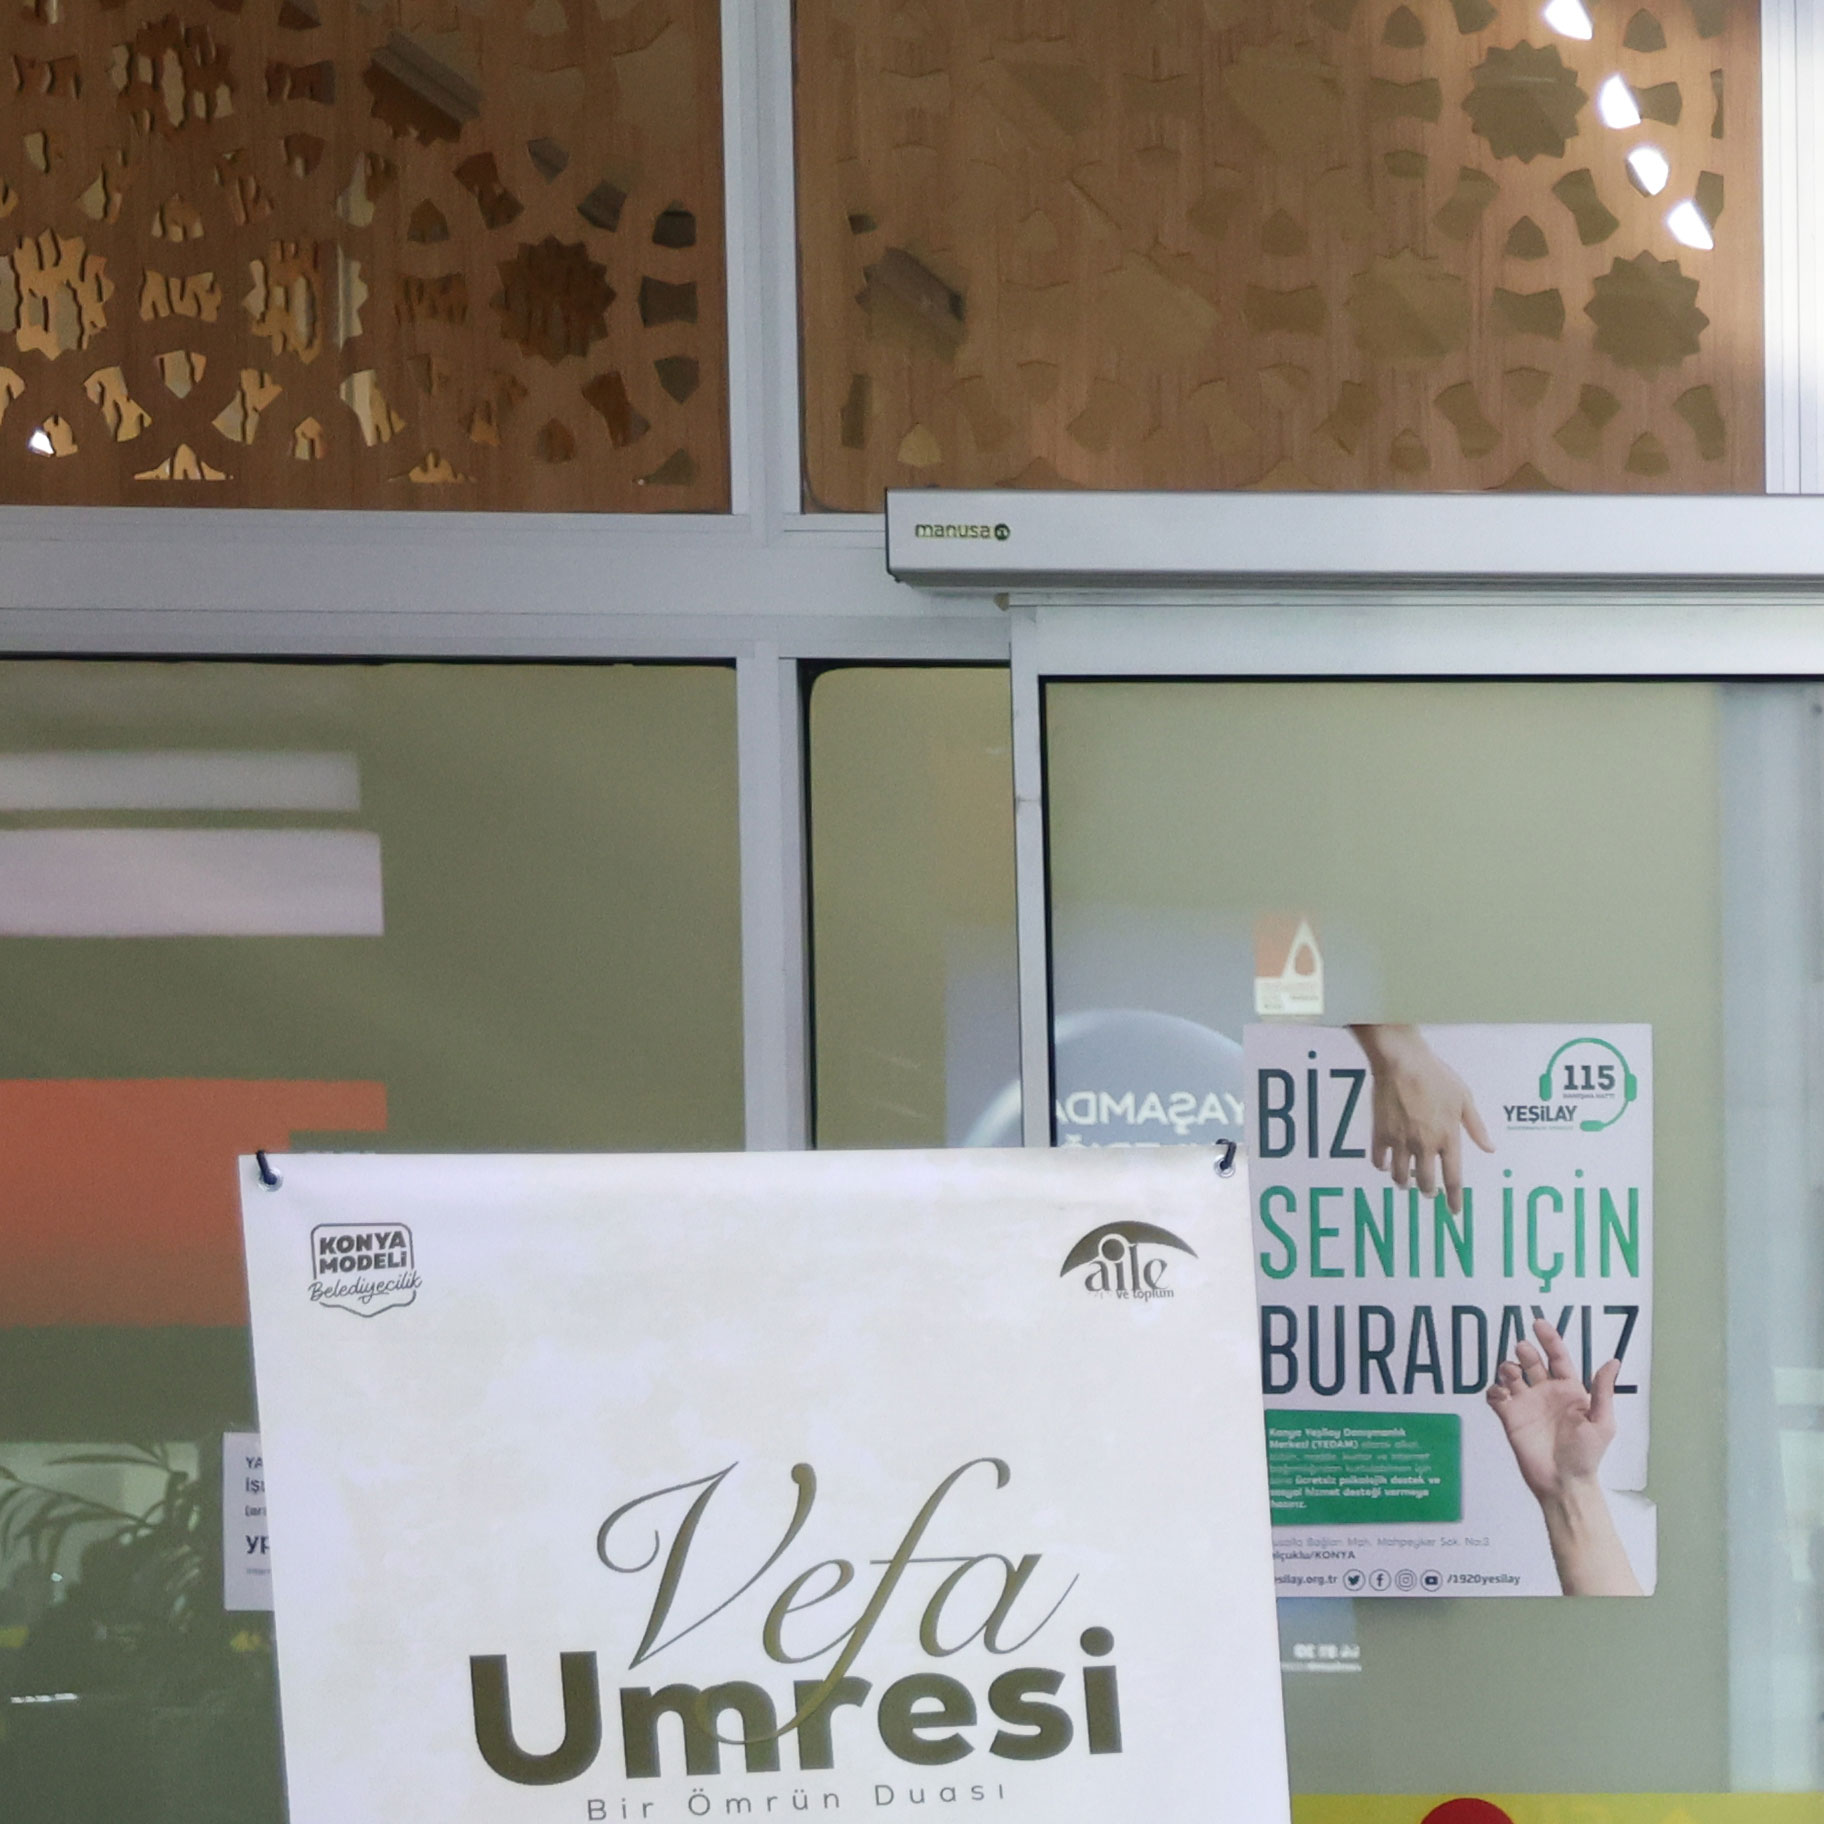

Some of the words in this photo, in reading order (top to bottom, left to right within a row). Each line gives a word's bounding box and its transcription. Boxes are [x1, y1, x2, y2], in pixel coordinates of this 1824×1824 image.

[914, 523, 991, 539] manusa
[1563, 1065, 1616, 1091] 115
[1257, 1050, 1366, 1159] BİZ
[1503, 1104, 1578, 1124] YEŞİLAY
[319, 1230, 407, 1256] KONYA
[1259, 1170, 1474, 1280] SENİN
[1502, 1168, 1640, 1293] İÇİN
[1084, 1237, 1169, 1292] aile
[308, 1270, 423, 1305] Belediyecilik
[597, 1457, 1080, 1746] Vefa
[469, 1625, 1124, 1787] Umresi
[586, 1796, 655, 1822] Bir
[687, 1787, 841, 1817] Ömrün
[873, 1782, 1005, 1807] Duası
